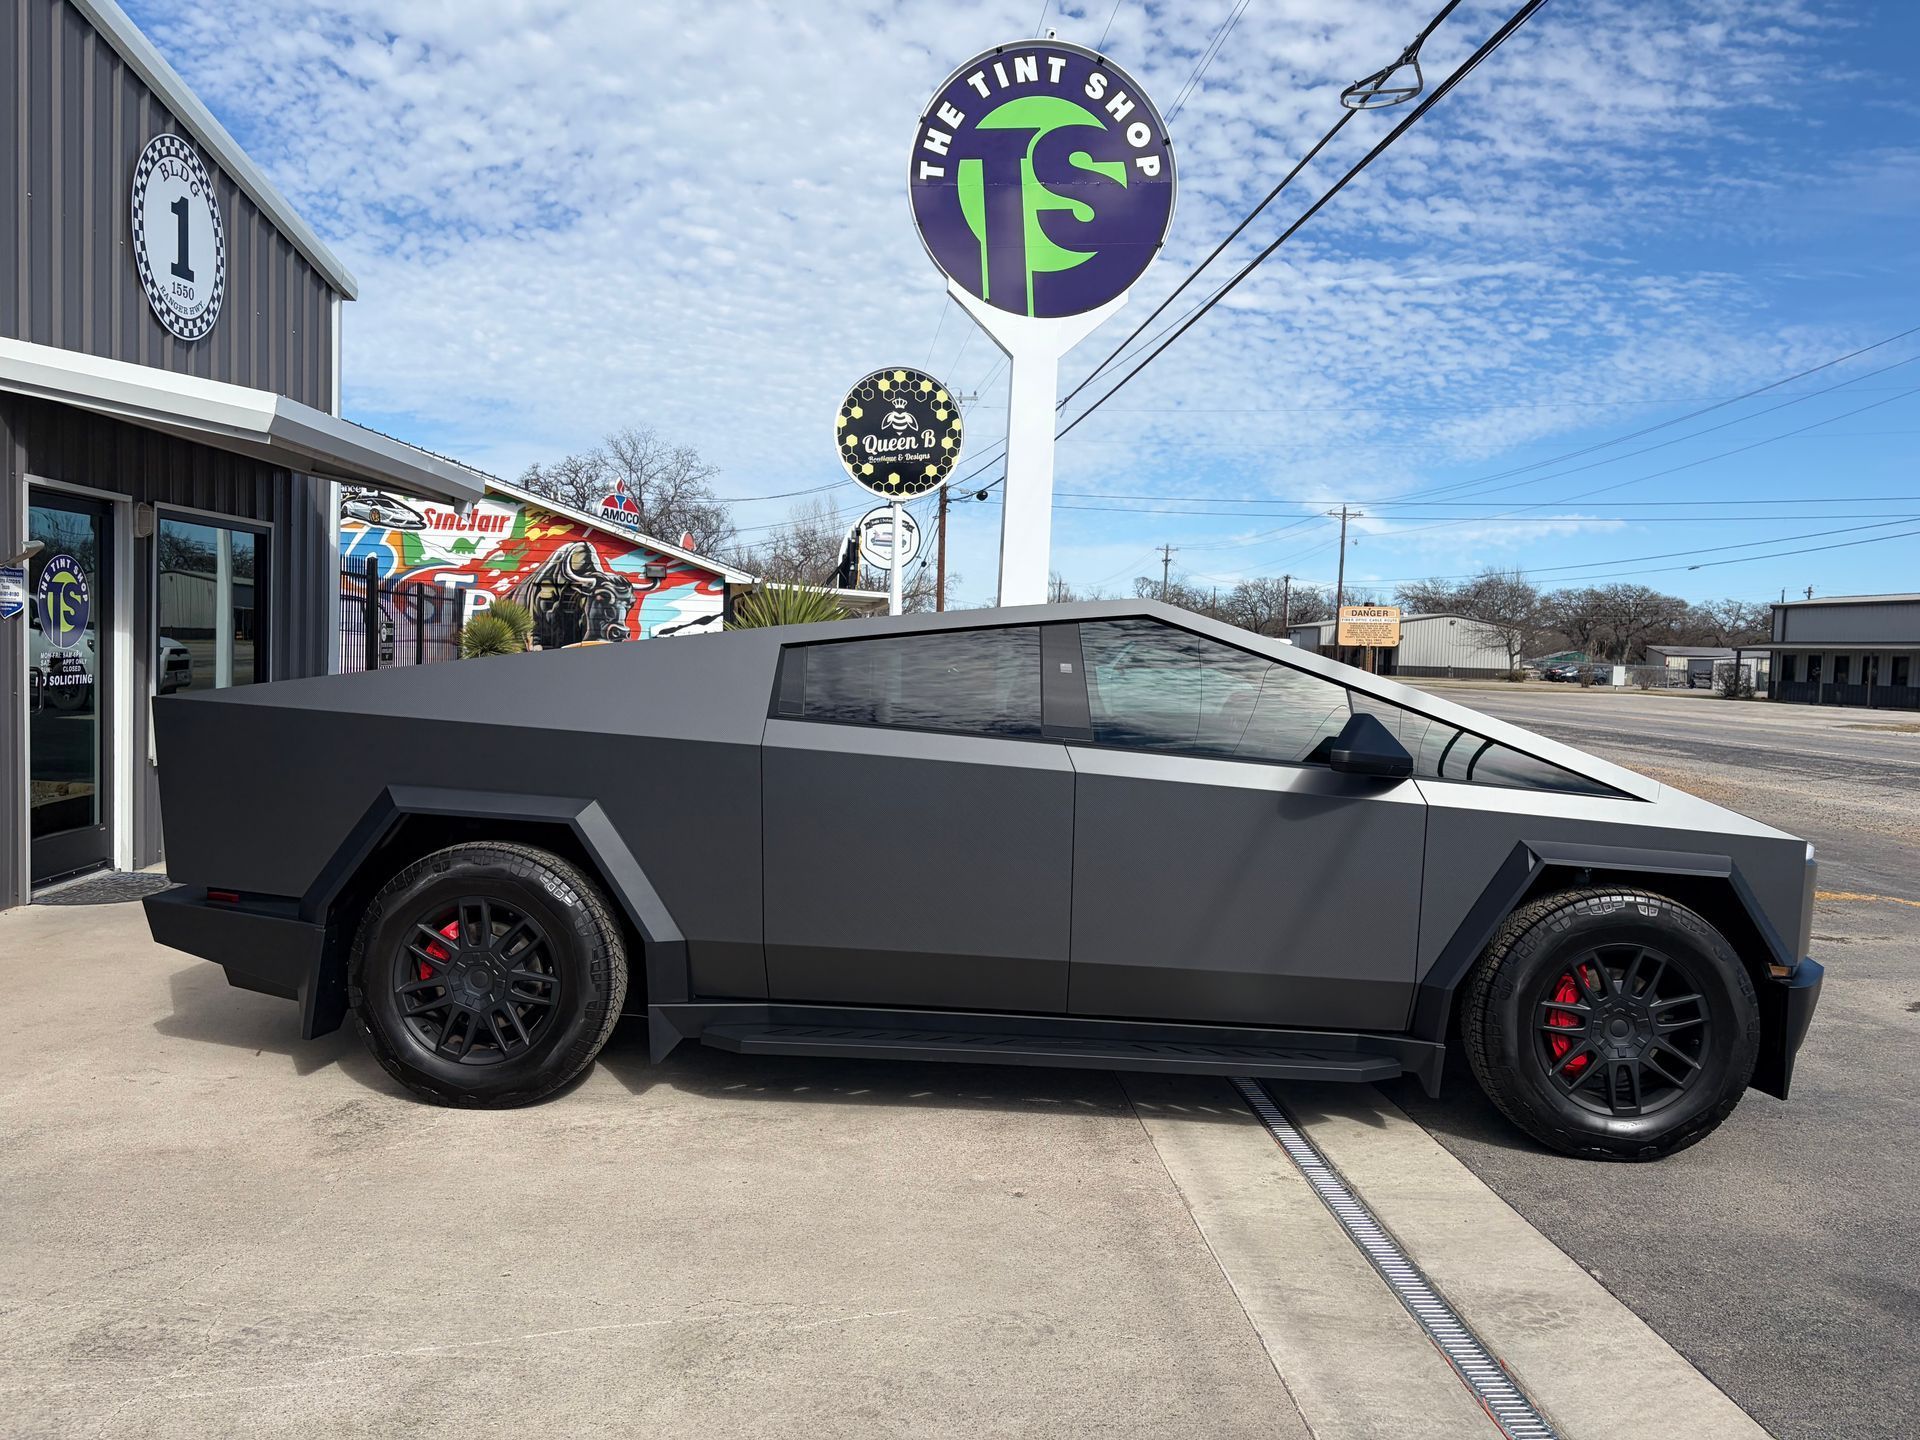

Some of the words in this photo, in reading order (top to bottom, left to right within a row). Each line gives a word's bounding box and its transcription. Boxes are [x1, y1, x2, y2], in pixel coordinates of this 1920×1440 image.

[919, 101, 966, 180] THE
[966, 55, 1067, 99] TINT
[1084, 72, 1161, 177] SHOP
[158, 159, 200, 198] BLDG
[170, 195, 195, 283] 1
[159, 284, 189, 315] RANGER
[171, 281, 195, 301] 1550
[862, 434, 919, 455] Queen
[921, 429, 936, 448] B
[868, 455, 897, 464] Boutique
[897, 453, 904, 461] &
[904, 453, 931, 462] Designs
[424, 507, 511, 532] Sinclair
[600, 507, 640, 525] AMOCO
[40, 572, 51, 600] THE
[50, 558, 71, 572] TINT
[73, 565, 88, 602] SHOP
[1351, 609, 1389, 617] DANGER
[49, 674, 93, 686] SOLICITING
